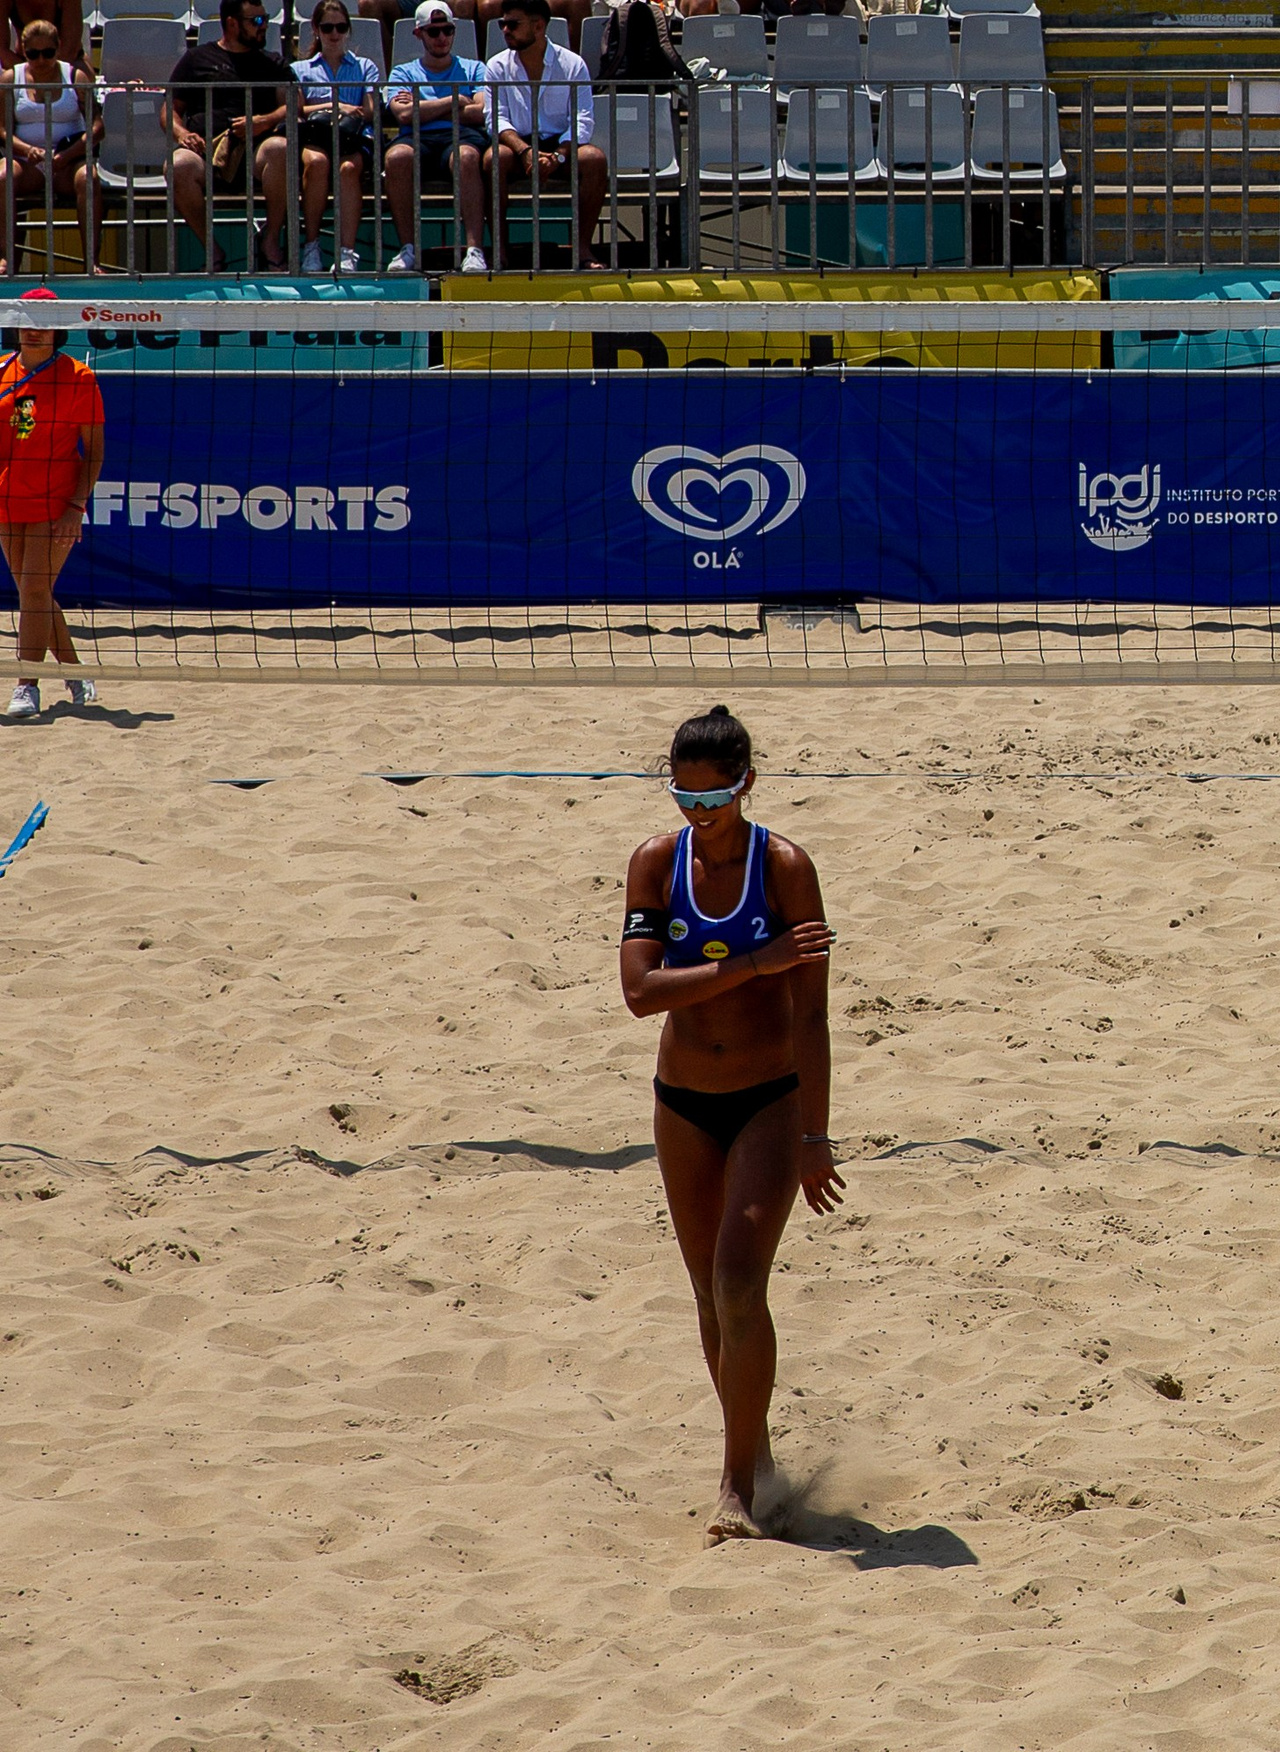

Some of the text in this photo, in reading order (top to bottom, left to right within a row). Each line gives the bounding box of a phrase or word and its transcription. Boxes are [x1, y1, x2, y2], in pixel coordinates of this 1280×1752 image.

[99, 309, 162, 323] Senoh
[1166, 489, 1243, 502] INSTITUTO
[82, 481, 412, 531] FFSPORTS
[1167, 512, 1190, 524] DO
[1194, 512, 1278, 525] DESPORTO
[693, 546, 741, 569] OLÁ
[751, 916, 769, 940] 2
